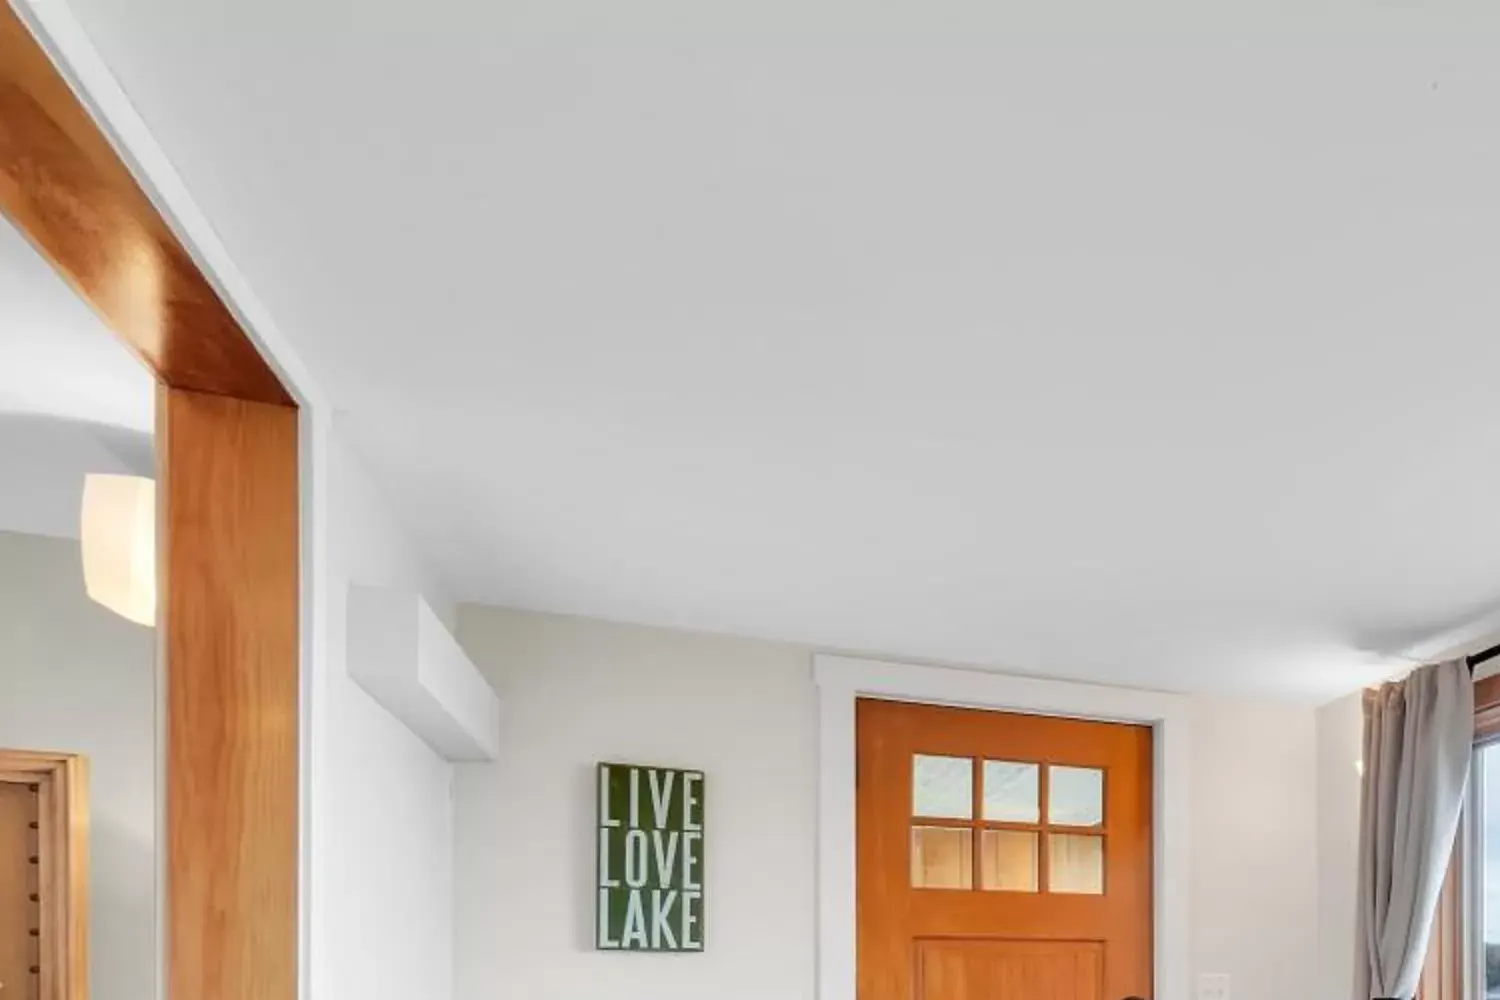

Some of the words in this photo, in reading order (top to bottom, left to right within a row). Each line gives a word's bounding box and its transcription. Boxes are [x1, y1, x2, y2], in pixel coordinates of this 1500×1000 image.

[601, 767, 702, 830] LIVE
[600, 828, 702, 890] LOVE
[599, 888, 701, 949] LAKE
